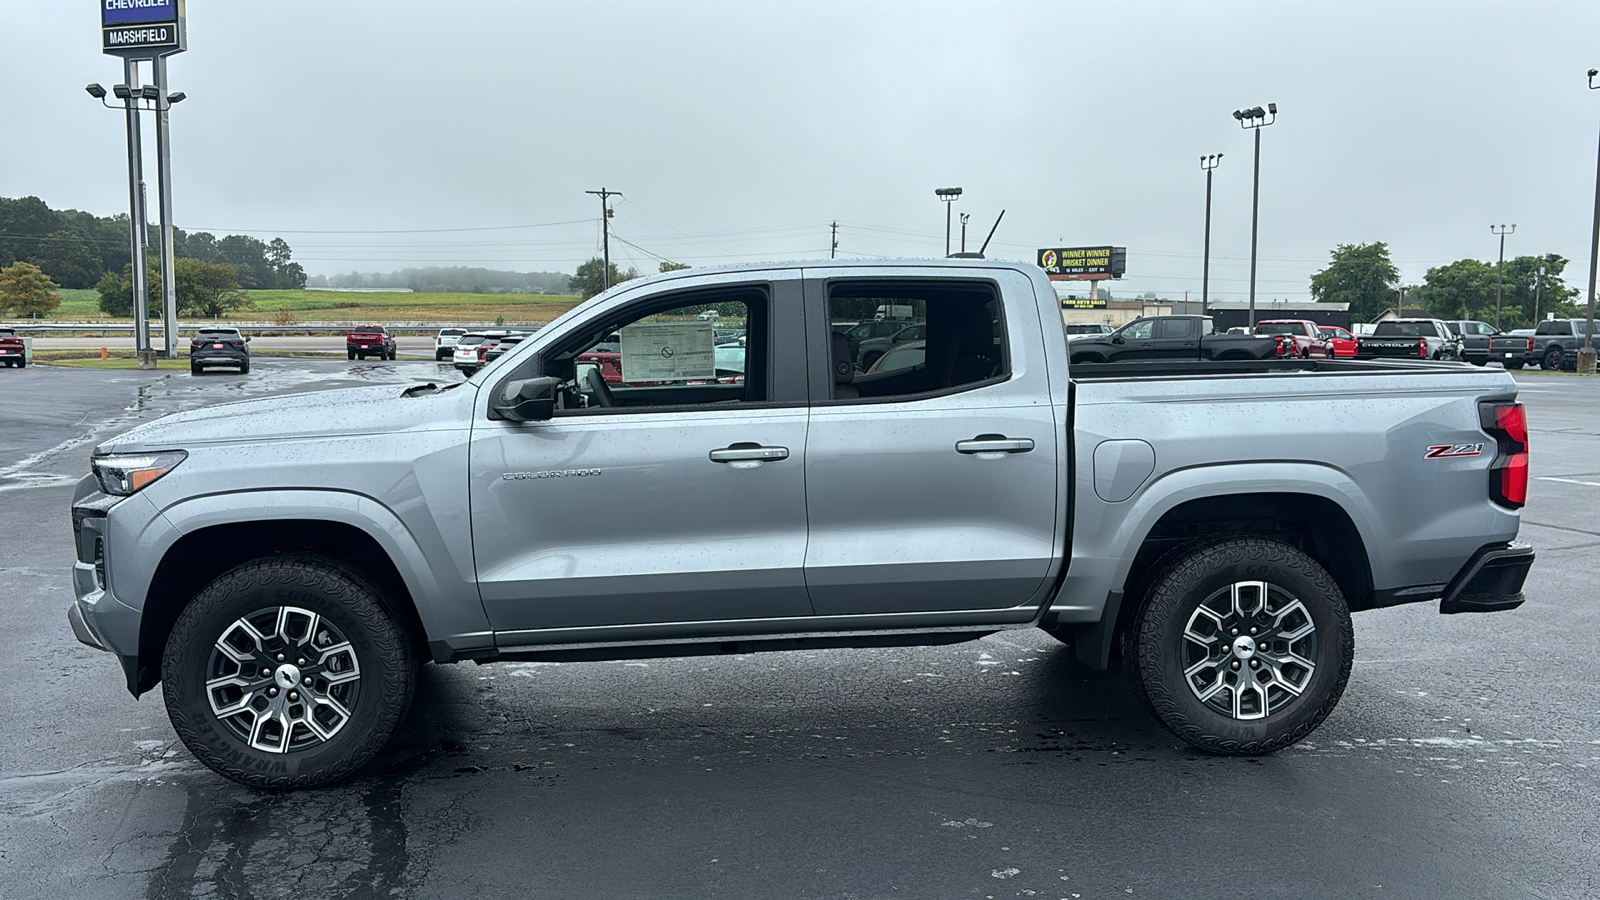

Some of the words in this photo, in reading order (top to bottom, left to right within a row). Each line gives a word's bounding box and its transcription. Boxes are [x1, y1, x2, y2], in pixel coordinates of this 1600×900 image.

[109, 28, 167, 44] MARSHFIELD
[1062, 250, 1085, 258] WINNER
[1086, 249, 1110, 258] WINNER
[1062, 259, 1086, 267] BRISKET
[1086, 258, 1109, 266] DINNER
[1424, 442, 1485, 459] Z71
[502, 468, 602, 480] COLORADO
